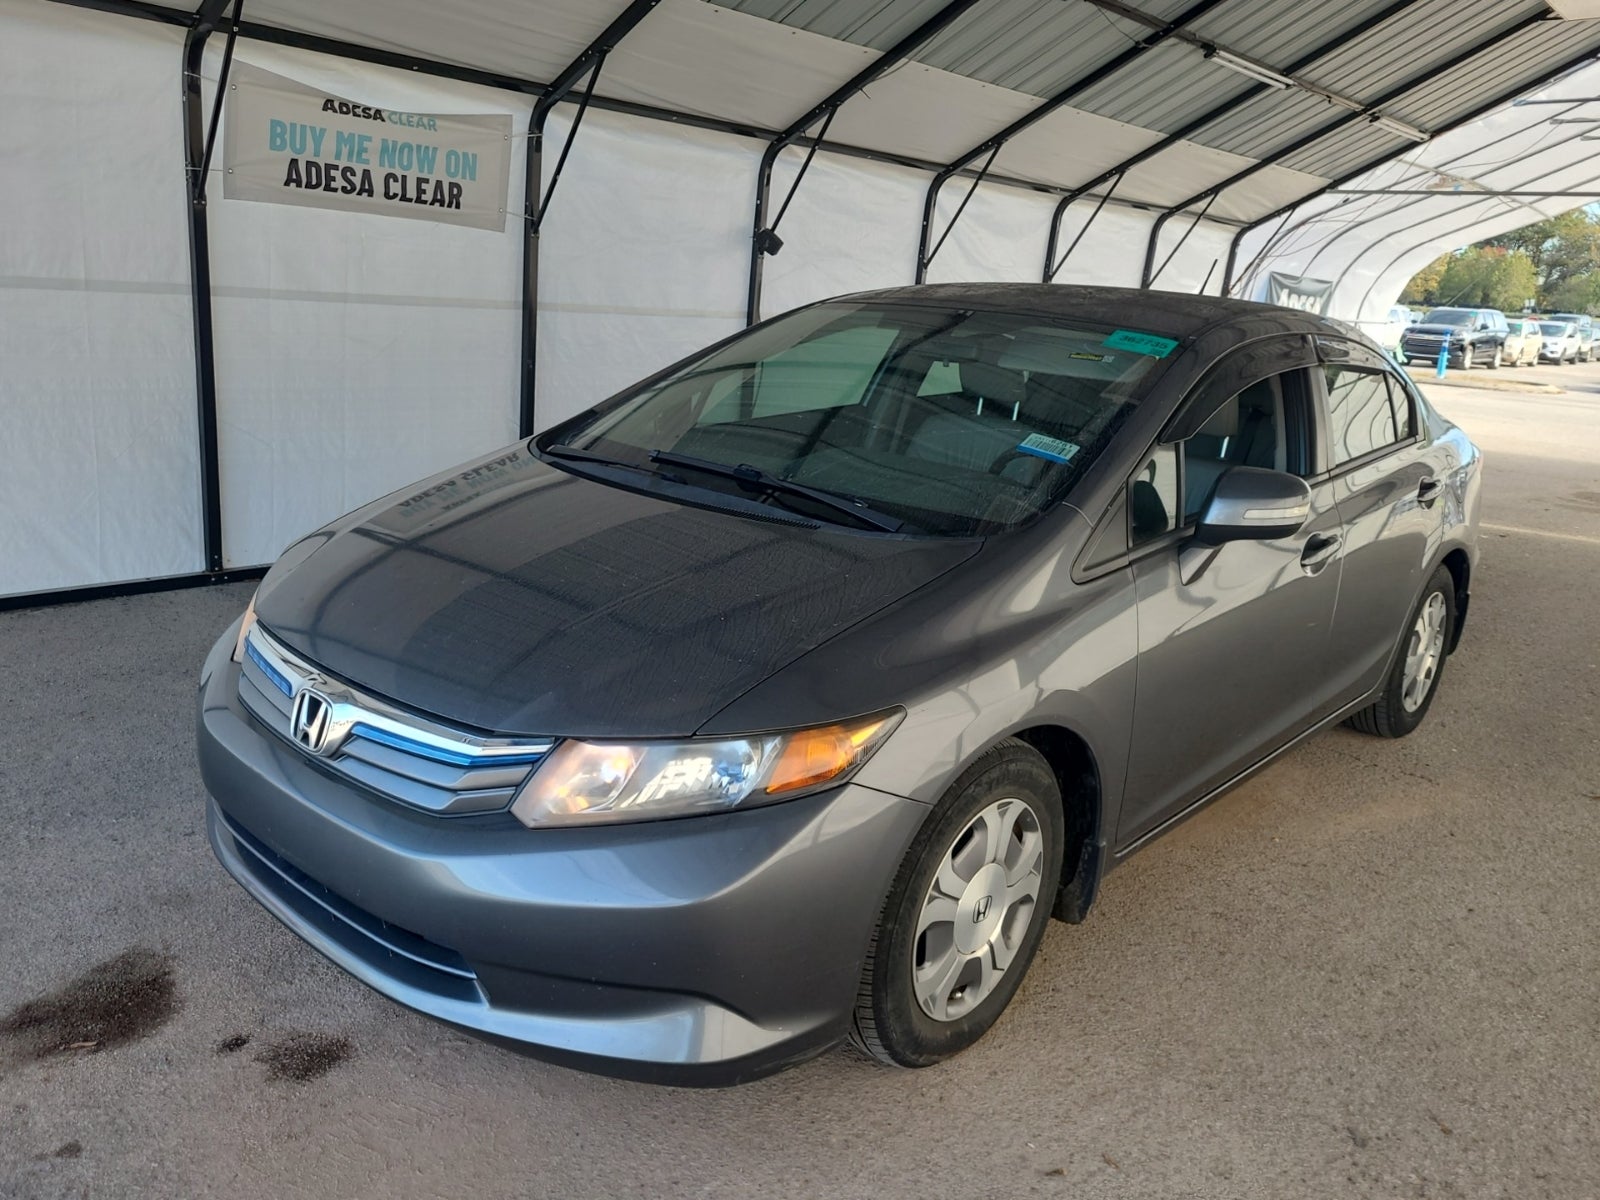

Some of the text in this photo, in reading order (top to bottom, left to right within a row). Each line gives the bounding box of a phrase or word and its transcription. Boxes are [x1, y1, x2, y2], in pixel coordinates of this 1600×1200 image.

[322, 98, 438, 132] ADESA CLEAR
[268, 118, 478, 182] BUY ME NOW ON
[283, 158, 464, 210] ADESA CLEAR
